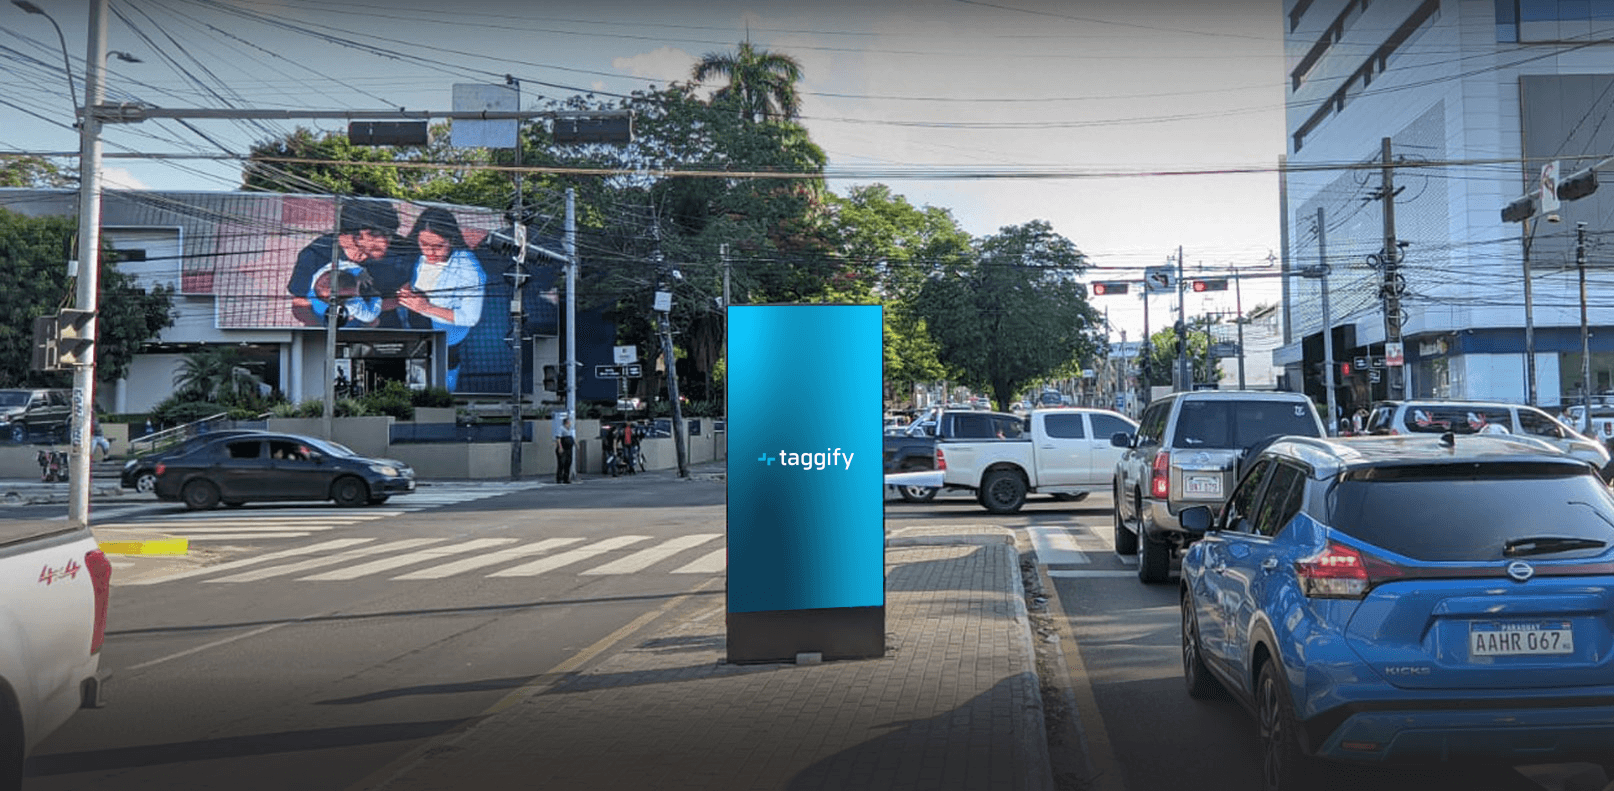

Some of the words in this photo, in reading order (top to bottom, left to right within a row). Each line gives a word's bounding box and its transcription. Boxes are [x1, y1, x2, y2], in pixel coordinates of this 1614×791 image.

[779, 447, 855, 471] taggify
[1476, 633, 1522, 652] AAHR
[1527, 632, 1560, 651] 067
[1385, 666, 1431, 676] KICKS
